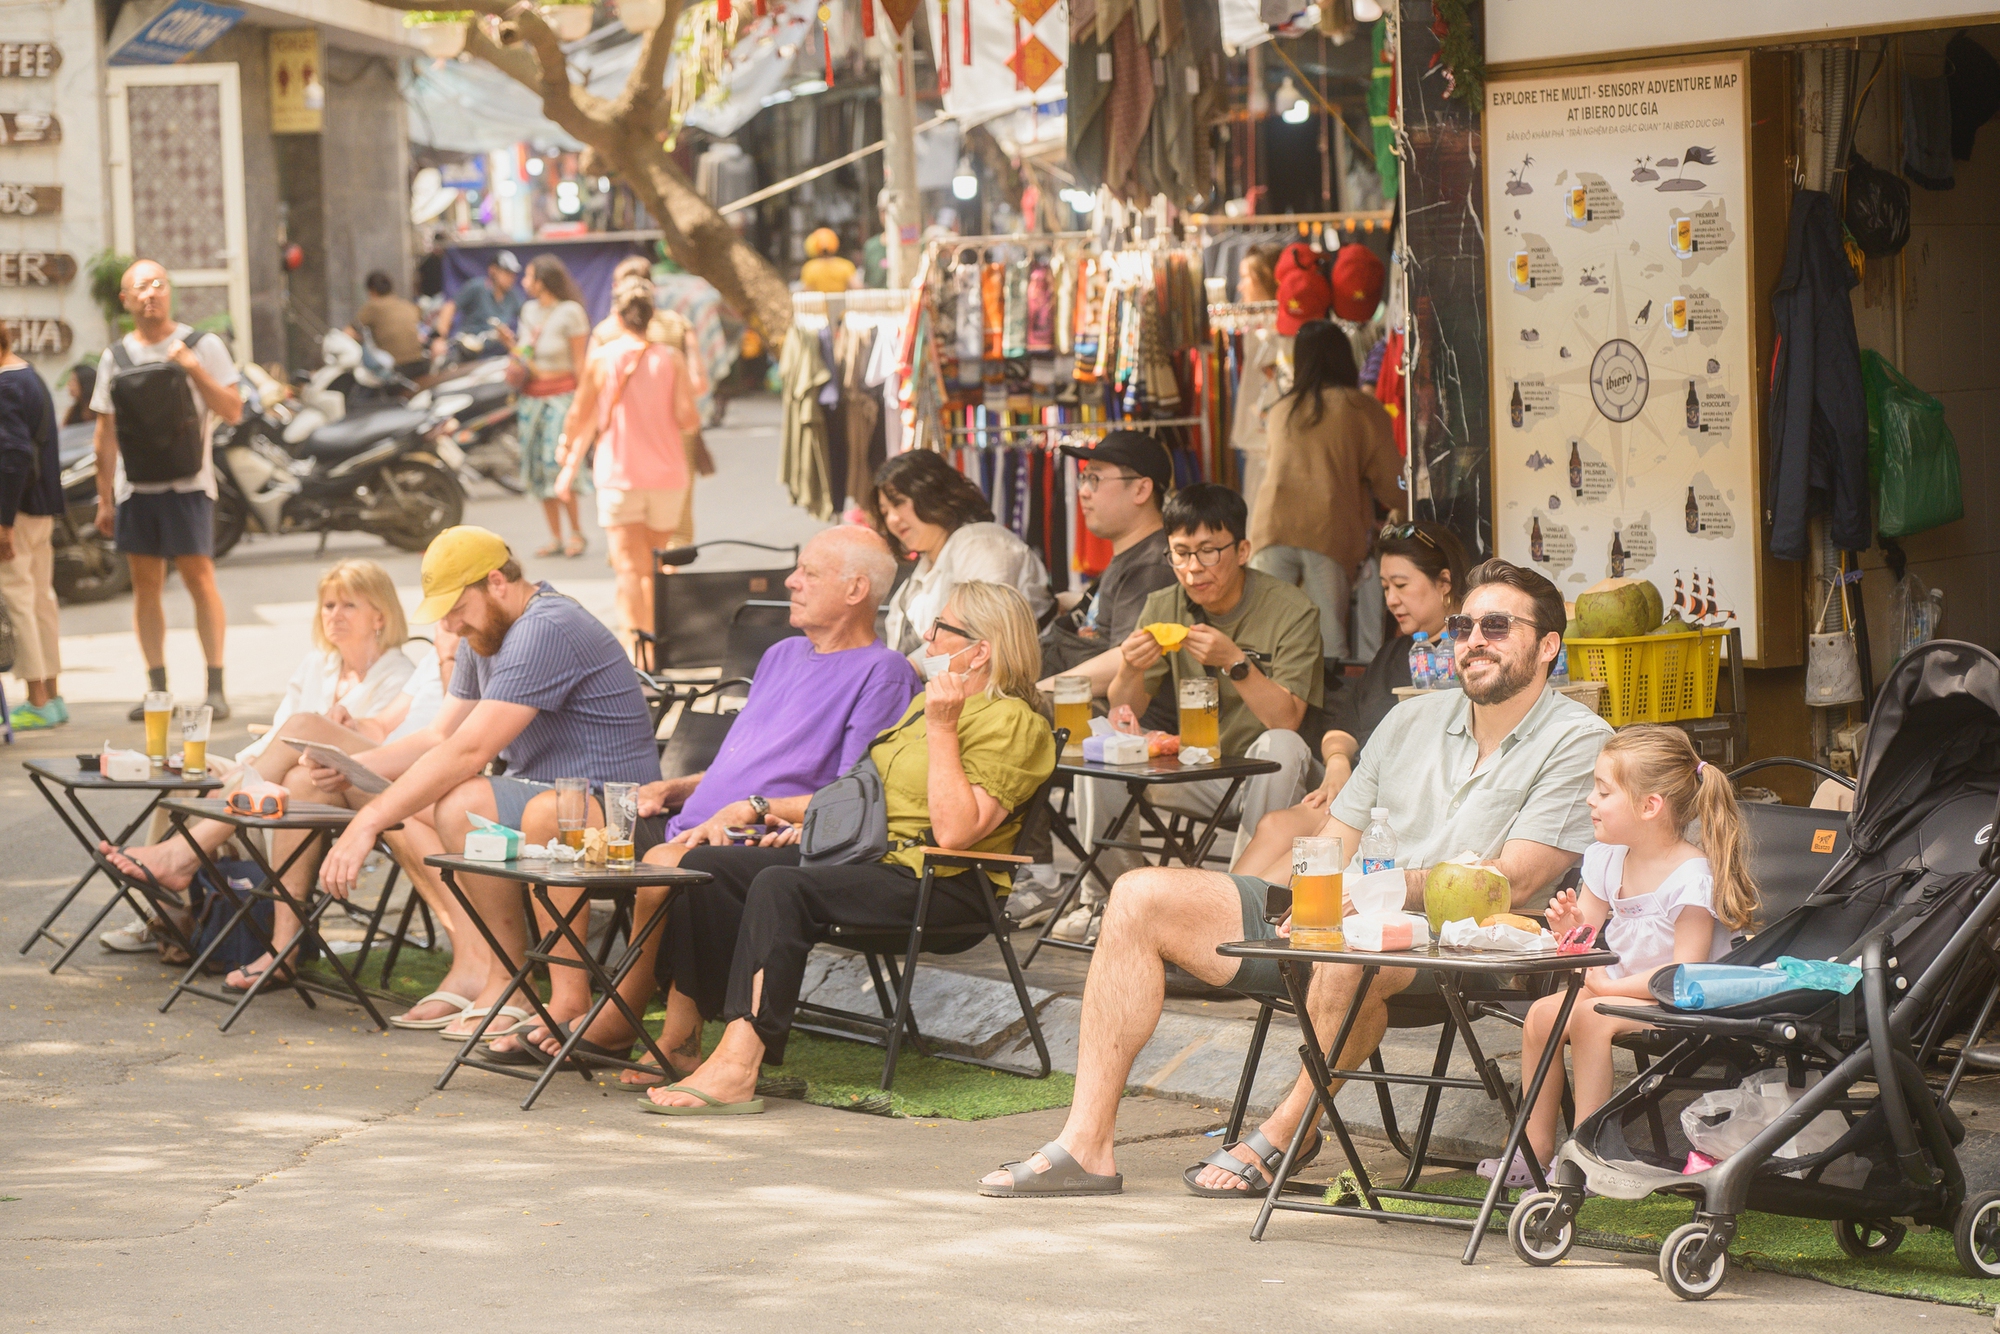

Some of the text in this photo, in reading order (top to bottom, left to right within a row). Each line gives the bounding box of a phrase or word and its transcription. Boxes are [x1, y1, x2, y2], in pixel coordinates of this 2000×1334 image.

[0, 44, 53, 78] FEE
[1493, 90, 1538, 106] EXPLORE
[1540, 88, 1559, 103] THE
[1561, 85, 1591, 102] MULTI
[1598, 81, 1645, 99] SENSORY
[1647, 76, 1712, 95] ADVENTURE
[1714, 73, 1738, 90] MAP
[1567, 101, 1659, 121] AT IBIERO DUC GIA
[1712, 117, 1726, 127] GIA
